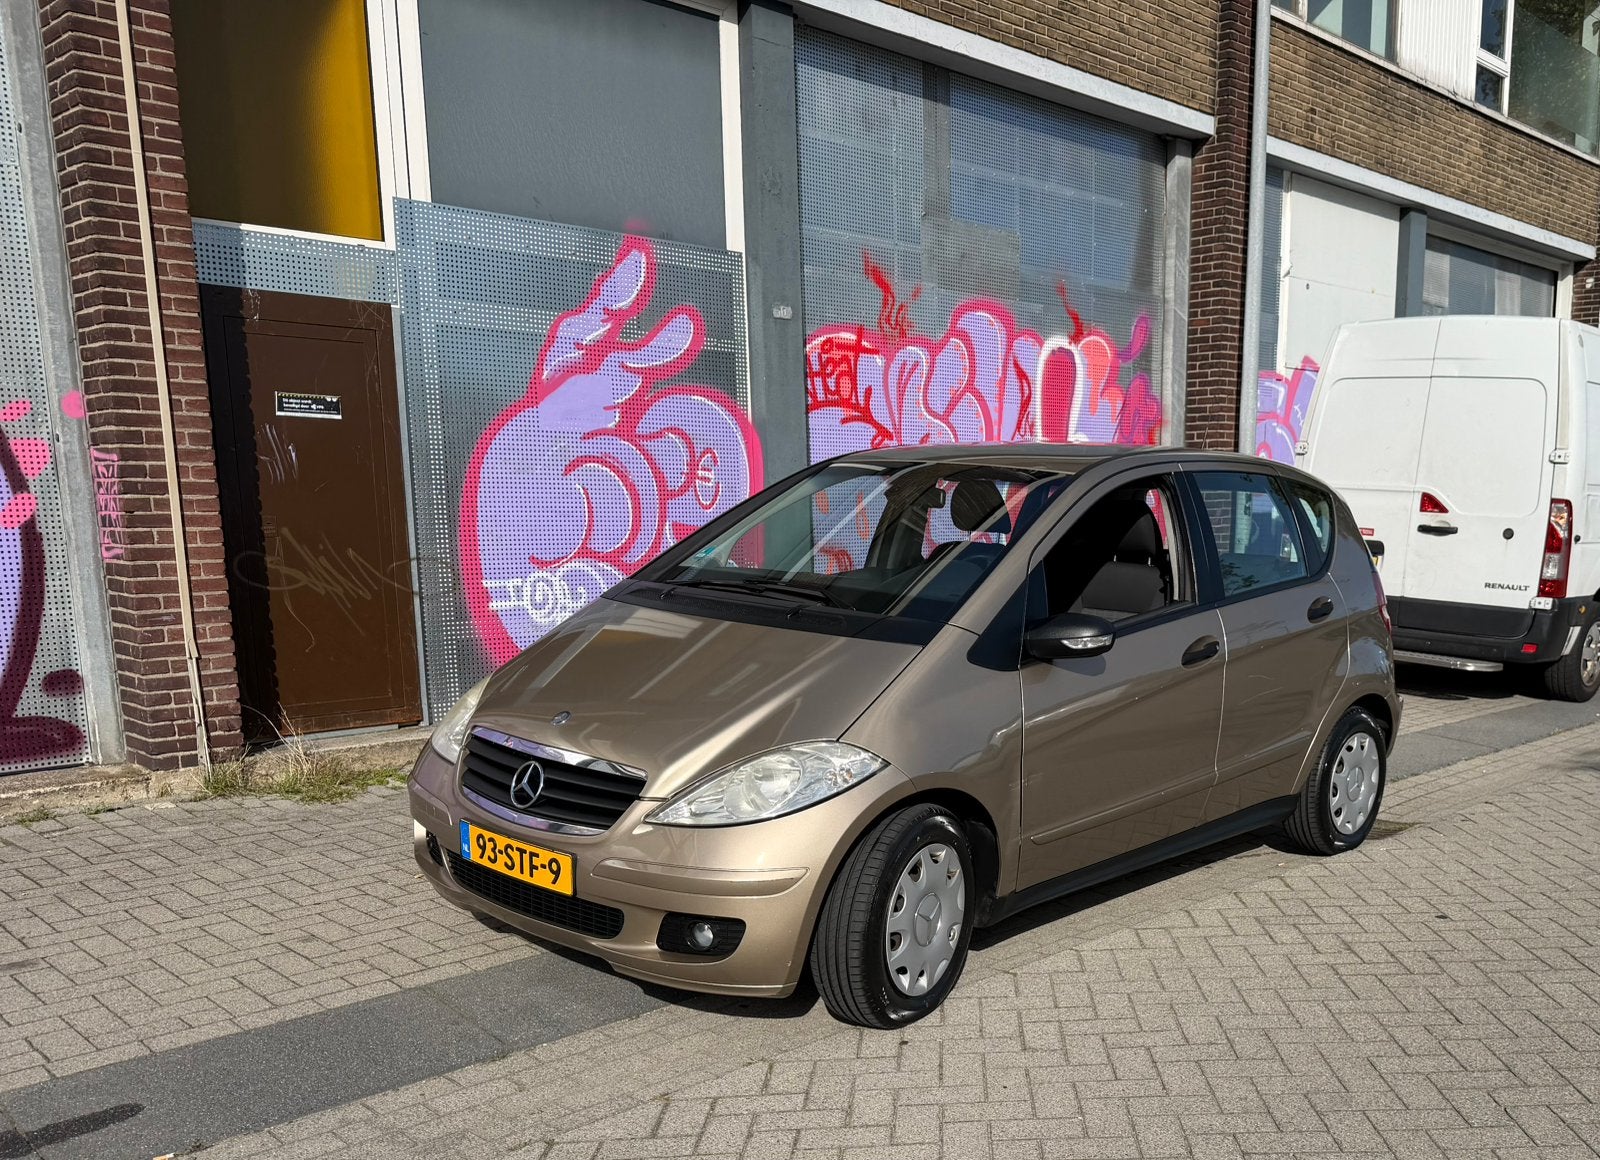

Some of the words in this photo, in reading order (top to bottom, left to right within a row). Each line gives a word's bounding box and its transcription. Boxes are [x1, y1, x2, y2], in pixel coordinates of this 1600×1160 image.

[1484, 582, 1530, 591] RENAULT
[462, 843, 470, 853] NL
[476, 833, 562, 885] 93-STF-9
